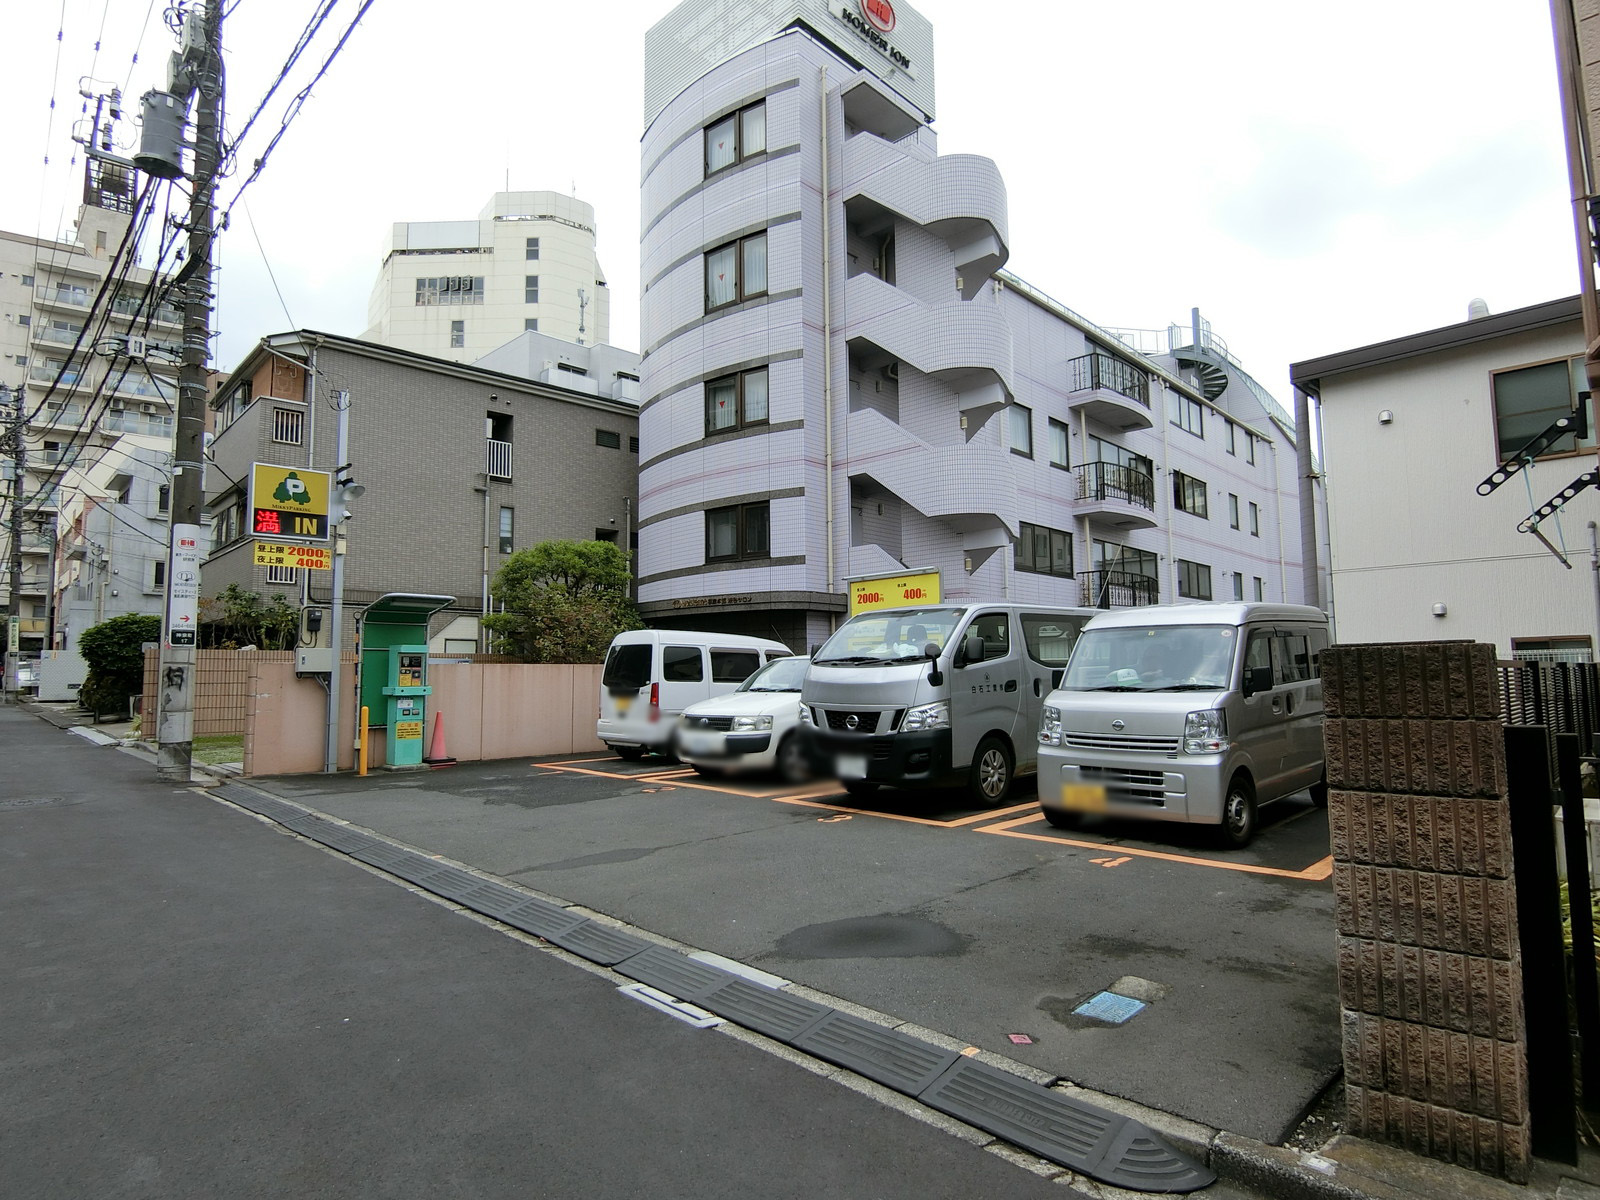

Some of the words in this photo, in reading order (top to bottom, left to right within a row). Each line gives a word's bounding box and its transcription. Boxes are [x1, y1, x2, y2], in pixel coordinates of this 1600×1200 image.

[842, 8, 888, 52] HOMER
[890, 46, 910, 69] ION
[256, 510, 281, 534] 満
[295, 516, 317, 535] IN
